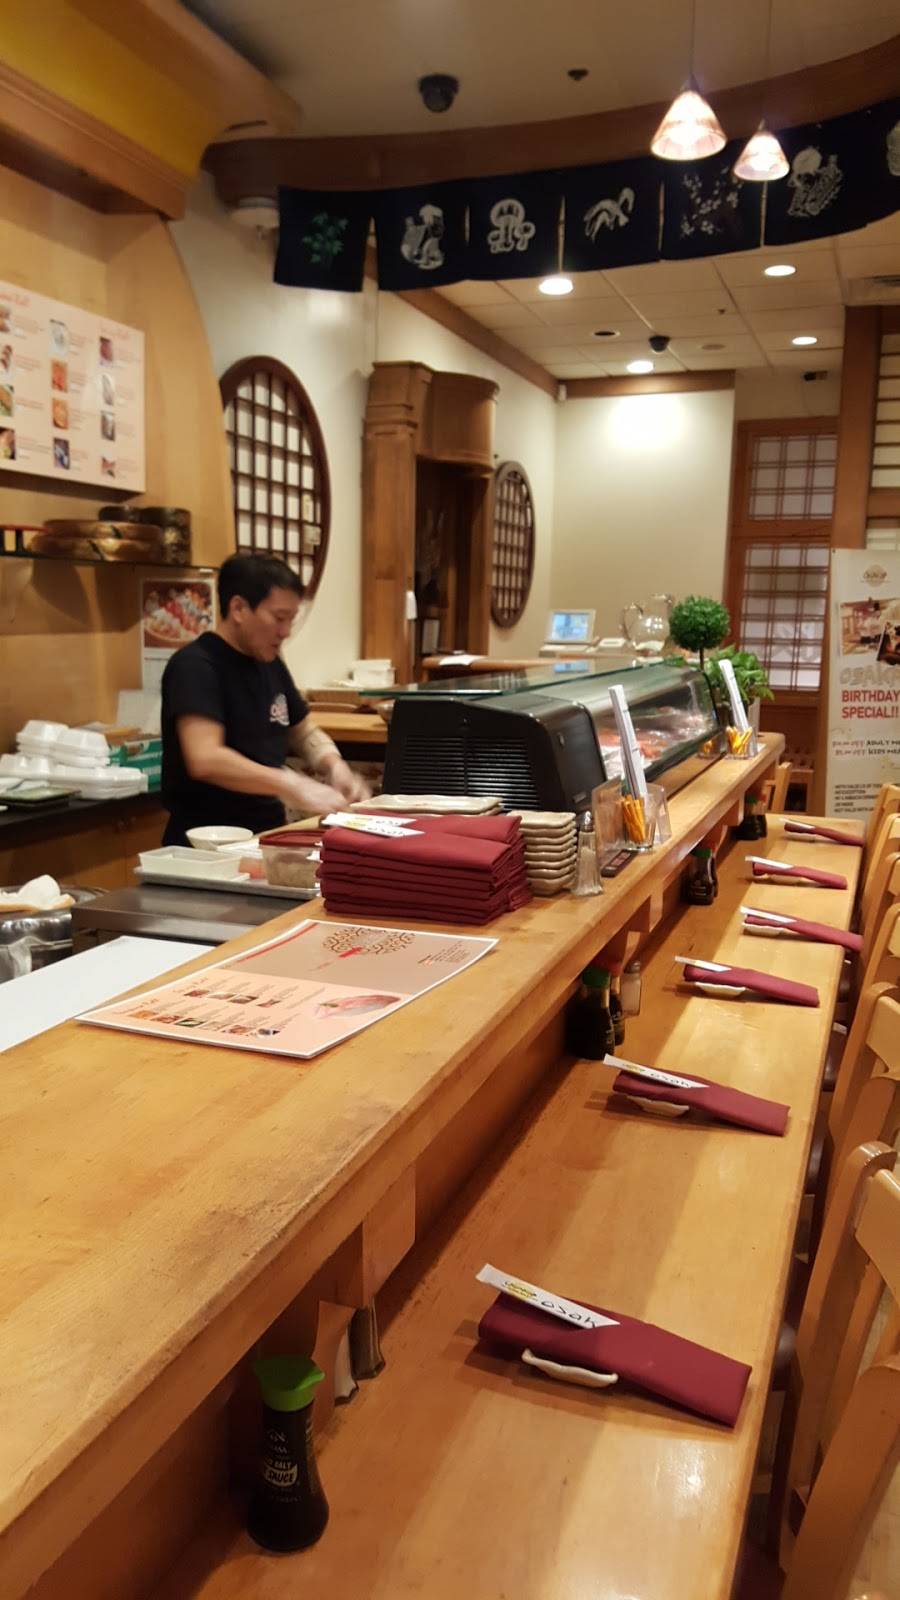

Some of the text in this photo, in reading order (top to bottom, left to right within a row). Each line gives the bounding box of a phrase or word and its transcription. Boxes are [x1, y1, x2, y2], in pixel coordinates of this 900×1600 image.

[841, 689, 900, 703] BIRTHDAY
[841, 706, 899, 719] SPECIAL!!
[268, 1469, 294, 1483] SAUCE
